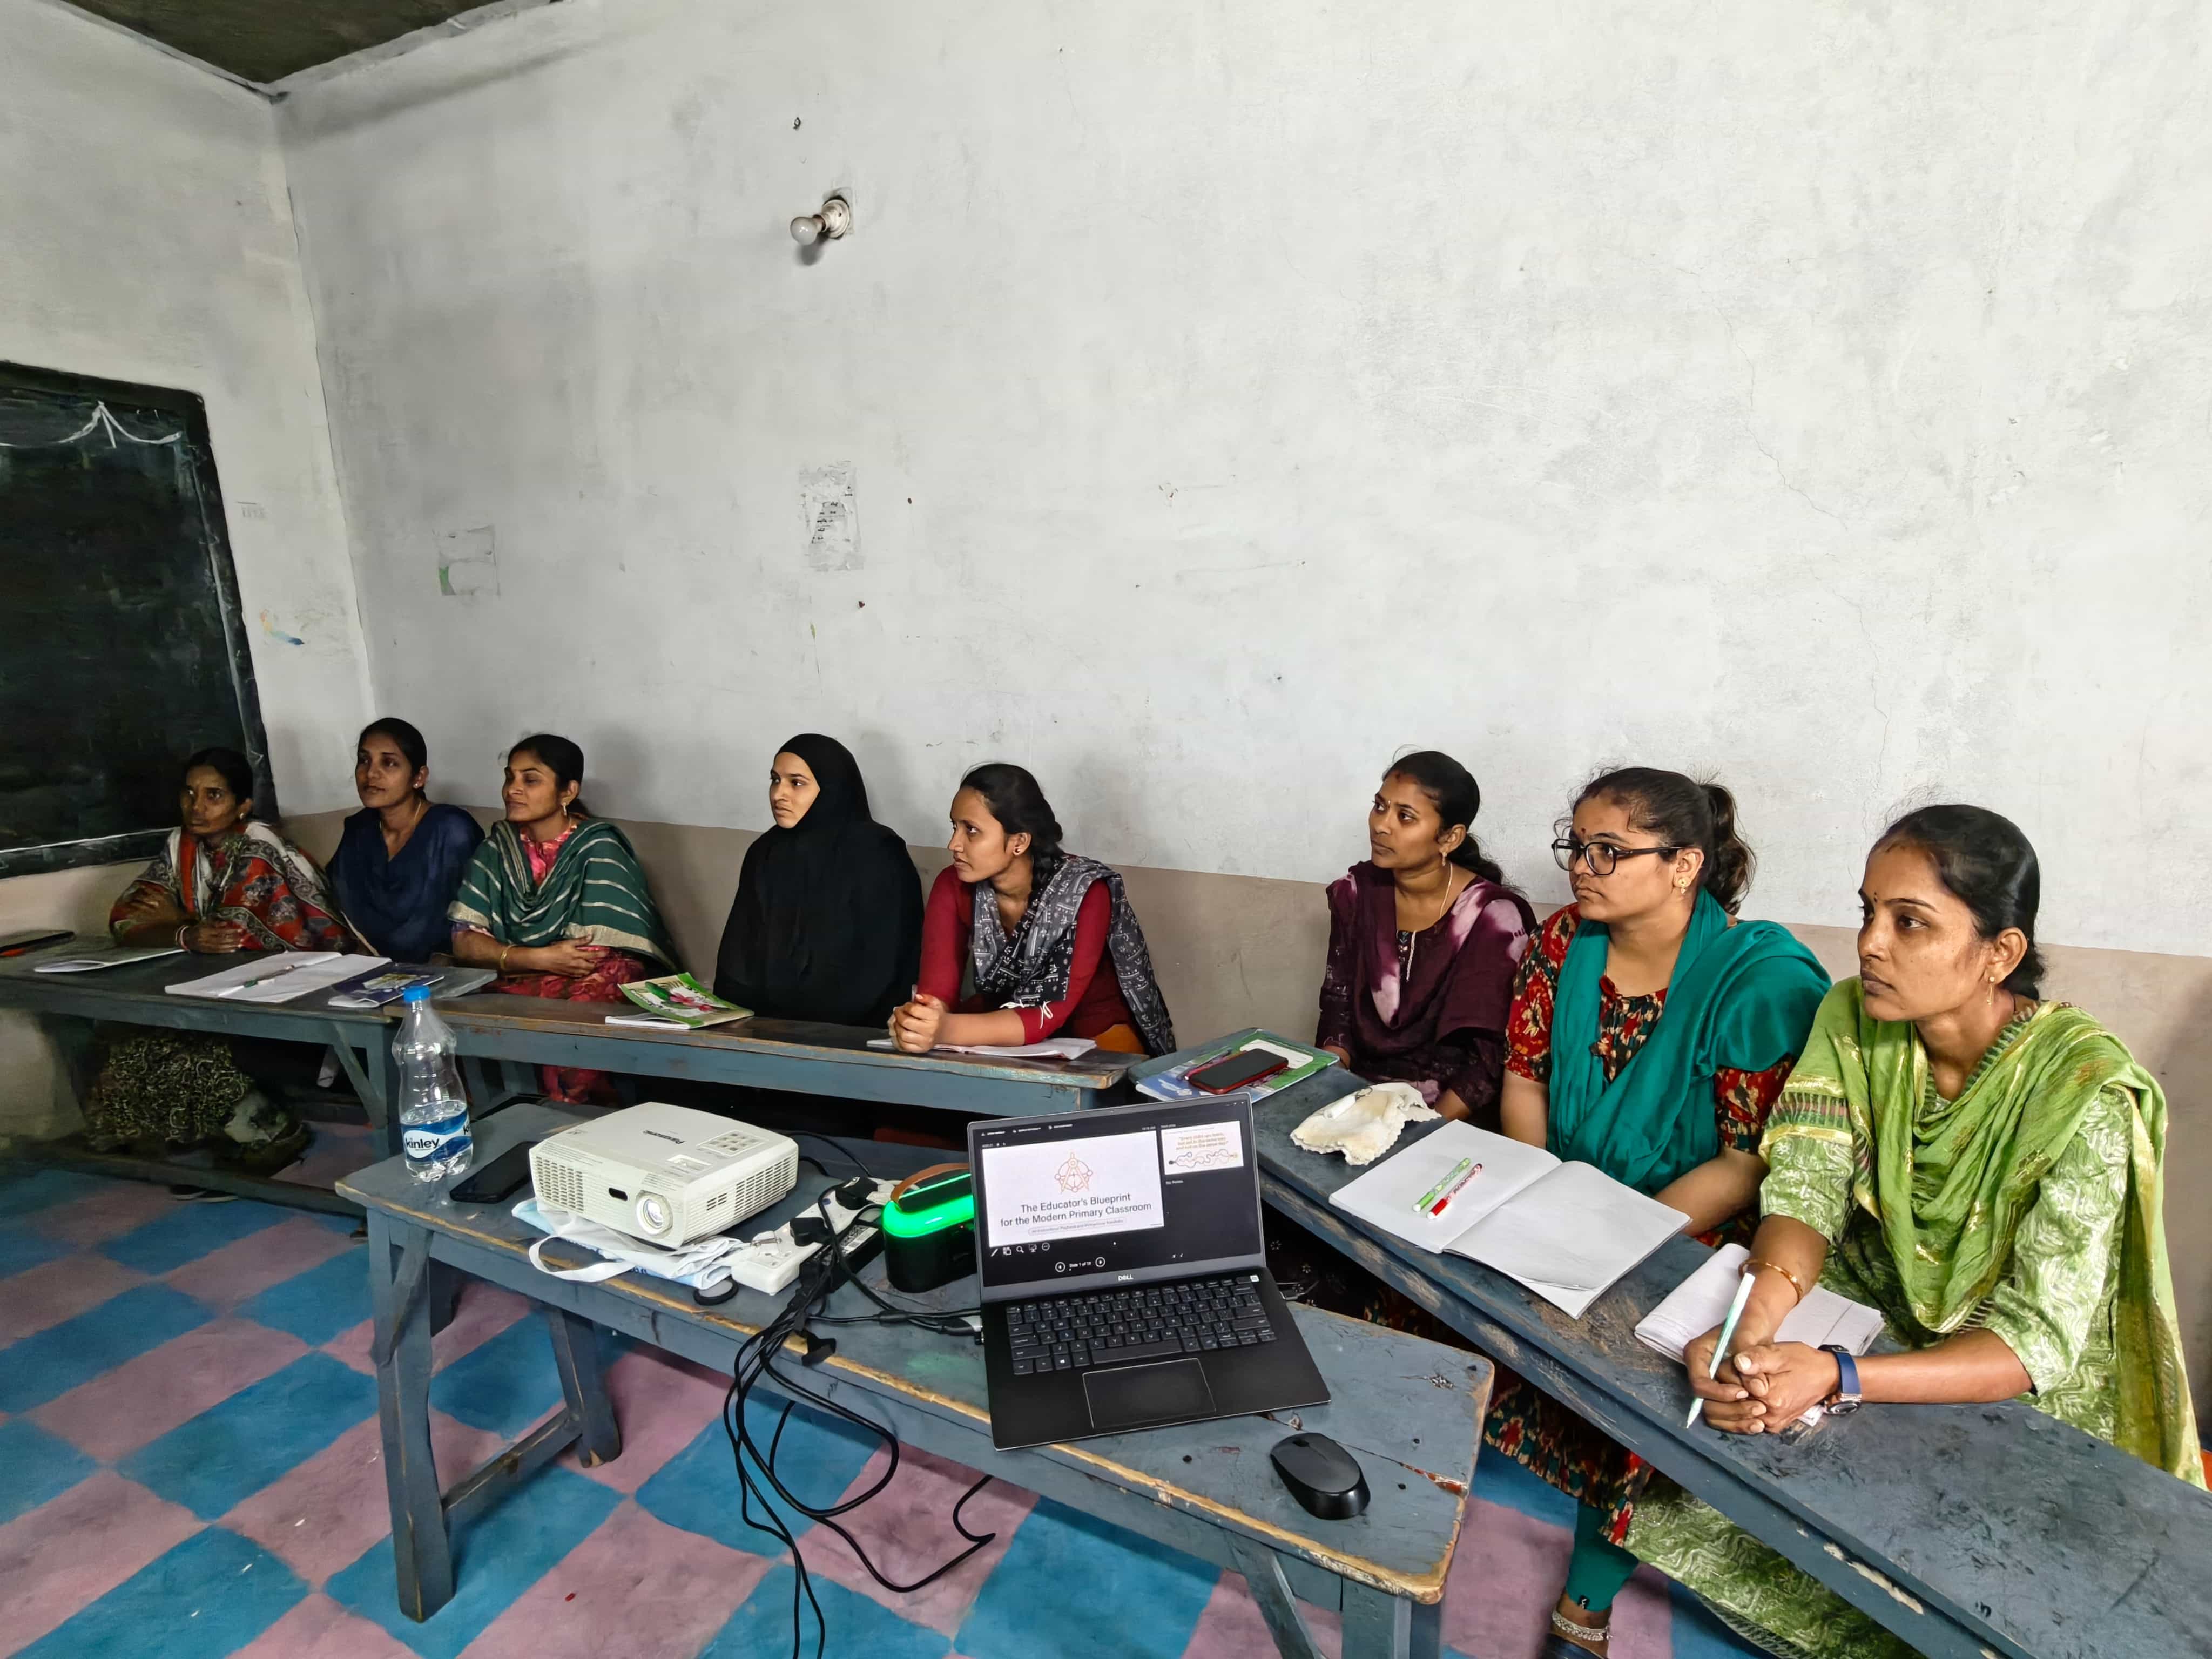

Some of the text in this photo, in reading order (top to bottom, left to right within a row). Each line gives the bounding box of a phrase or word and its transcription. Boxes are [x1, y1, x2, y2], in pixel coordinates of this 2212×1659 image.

[406, 1137, 440, 1149] kinley
[1021, 1193, 1131, 1213] The Educator's Blueprint
[1000, 1203, 1151, 1227] for the Modern Primary Classroom
